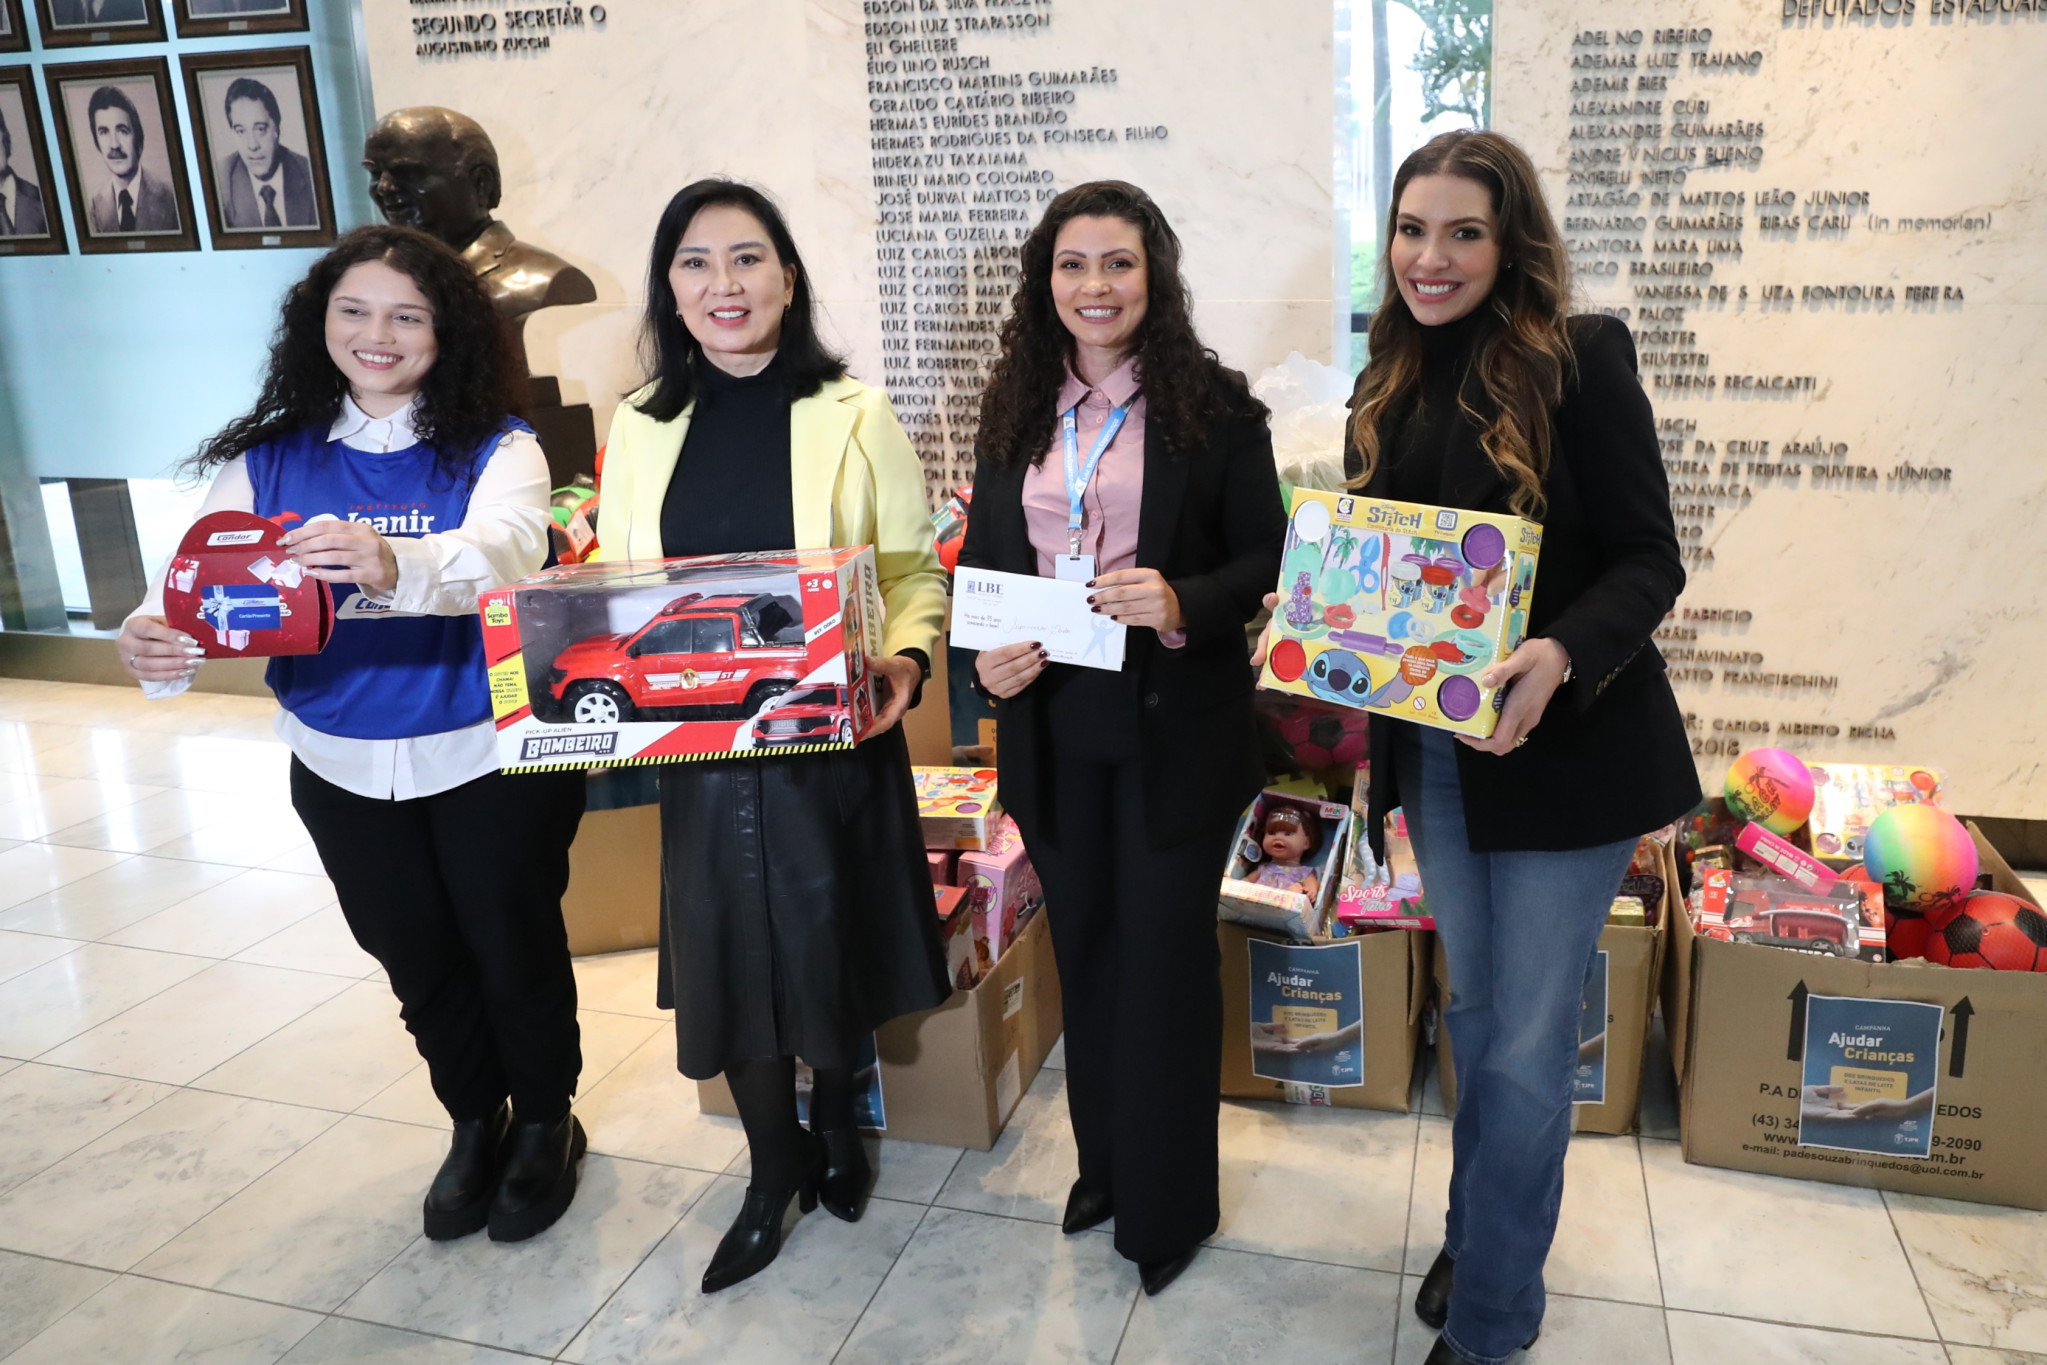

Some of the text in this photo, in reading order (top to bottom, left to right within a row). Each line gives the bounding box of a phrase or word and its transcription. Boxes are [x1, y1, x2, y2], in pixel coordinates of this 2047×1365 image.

[864, 0, 914, 15] EDSON
[920, 0, 938, 11] DA
[412, 13, 497, 35] SEGUNDO
[865, 13, 1050, 36] EDSON LUIZ STRAPASSON
[416, 36, 550, 56] AUGUSTINHO ZUCCHI
[1653, 28, 1712, 46] RIBEIRO
[866, 37, 958, 56] ELI GHELLERE
[867, 56, 990, 75] ÉLIO LINO RUSCH
[1571, 51, 1763, 69] ADEMAR LUIZ TRAIANO
[868, 67, 1117, 94] FRANCISCO MARTINS GUIMARÃES
[1570, 75, 1667, 92] ADEMIR BIER
[870, 90, 1075, 113] GERALDO CARTÁRIO RIBEIRO
[1569, 99, 1709, 116] ALEXANDRE CURI
[870, 107, 1067, 131] HERMAS EURÍDES BRANDÃO
[871, 125, 1168, 150] HERMES RODRIGUES DA FONSECA FILHO
[1569, 119, 1764, 140] ALEXANDRE GUIMARÃES
[872, 154, 944, 169] HIDEKAZU
[1705, 146, 1763, 163] BUENO
[873, 169, 1054, 188] IRINEU MARIO COLOMBO
[1567, 170, 1687, 185] ANIBELLI NETO
[875, 188, 912, 206] JOSÉ
[917, 191, 967, 205] DURVAL
[973, 189, 1031, 203] MATTOS
[1566, 188, 1870, 207] ARTAGÃO DE MATTOS LEÃO JUNIOR
[919, 211, 963, 223] MARIA
[968, 208, 1029, 222] FERREIRA
[1565, 216, 1646, 232] BERNARDO
[1655, 213, 1744, 231] GUIMARÃES
[1760, 215, 1800, 230] RIBAS
[1808, 215, 1851, 230] CARLI
[876, 229, 938, 243] LUCIANA
[945, 228, 1008, 241] GUZELLA
[1565, 239, 1743, 254] CANTORA MARA LIMA
[878, 265, 1019, 279] LUIZ CARLOS CAITO
[1630, 262, 1713, 277] BRASILEIRO
[1635, 285, 1895, 300] VANESSA DE FONTOURA
[880, 302, 907, 315] LUIZ
[914, 302, 969, 315] CARLOS
[1639, 307, 1684, 321] PALOZ
[881, 320, 995, 333] LUIZ FERNANDES
[883, 338, 994, 351] LUIZ FERNANDO
[884, 357, 911, 369] LUIZ
[917, 357, 977, 370] ROBERTO
[1641, 353, 1709, 367] SILVESTRI
[1654, 375, 1817, 390] RUBENS RECALCATTI
[889, 394, 936, 406] MILTON
[1695, 440, 1716, 453] DA
[1726, 440, 1770, 454] CRUZ
[1782, 435, 1848, 455] ARAÚJO
[1721, 462, 1740, 475] DE
[1747, 462, 1801, 477] FREITAS
[1812, 464, 1878, 480] OLIVEIRA
[1887, 460, 1952, 481] JÚNIOR
[978, 581, 1004, 595] LBE
[1662, 647, 1764, 664] SCHIAVINATO
[1724, 671, 1838, 689] FRANCISCHINI
[1713, 718, 1770, 733] CARLOS
[1778, 723, 1839, 738] ALBERTO
[1849, 726, 1896, 741] RICHA
[1691, 737, 1739, 756] 2018
[1341, 884, 1388, 903] Sports
[1267, 972, 1313, 987] Ajudar
[1281, 986, 1342, 1004] Crianças
[1828, 1032, 1883, 1048] Ajudar
[1844, 1047, 1915, 1066] Crianças
[1760, 1083, 1982, 1119] P.A EDOS
[1752, 1113, 1982, 1151] (43) 9-2090
[1742, 1143, 1780, 1156] e-mail:
[1783, 1150, 1985, 1181] padesouzabrinquedos@uol.com.br
